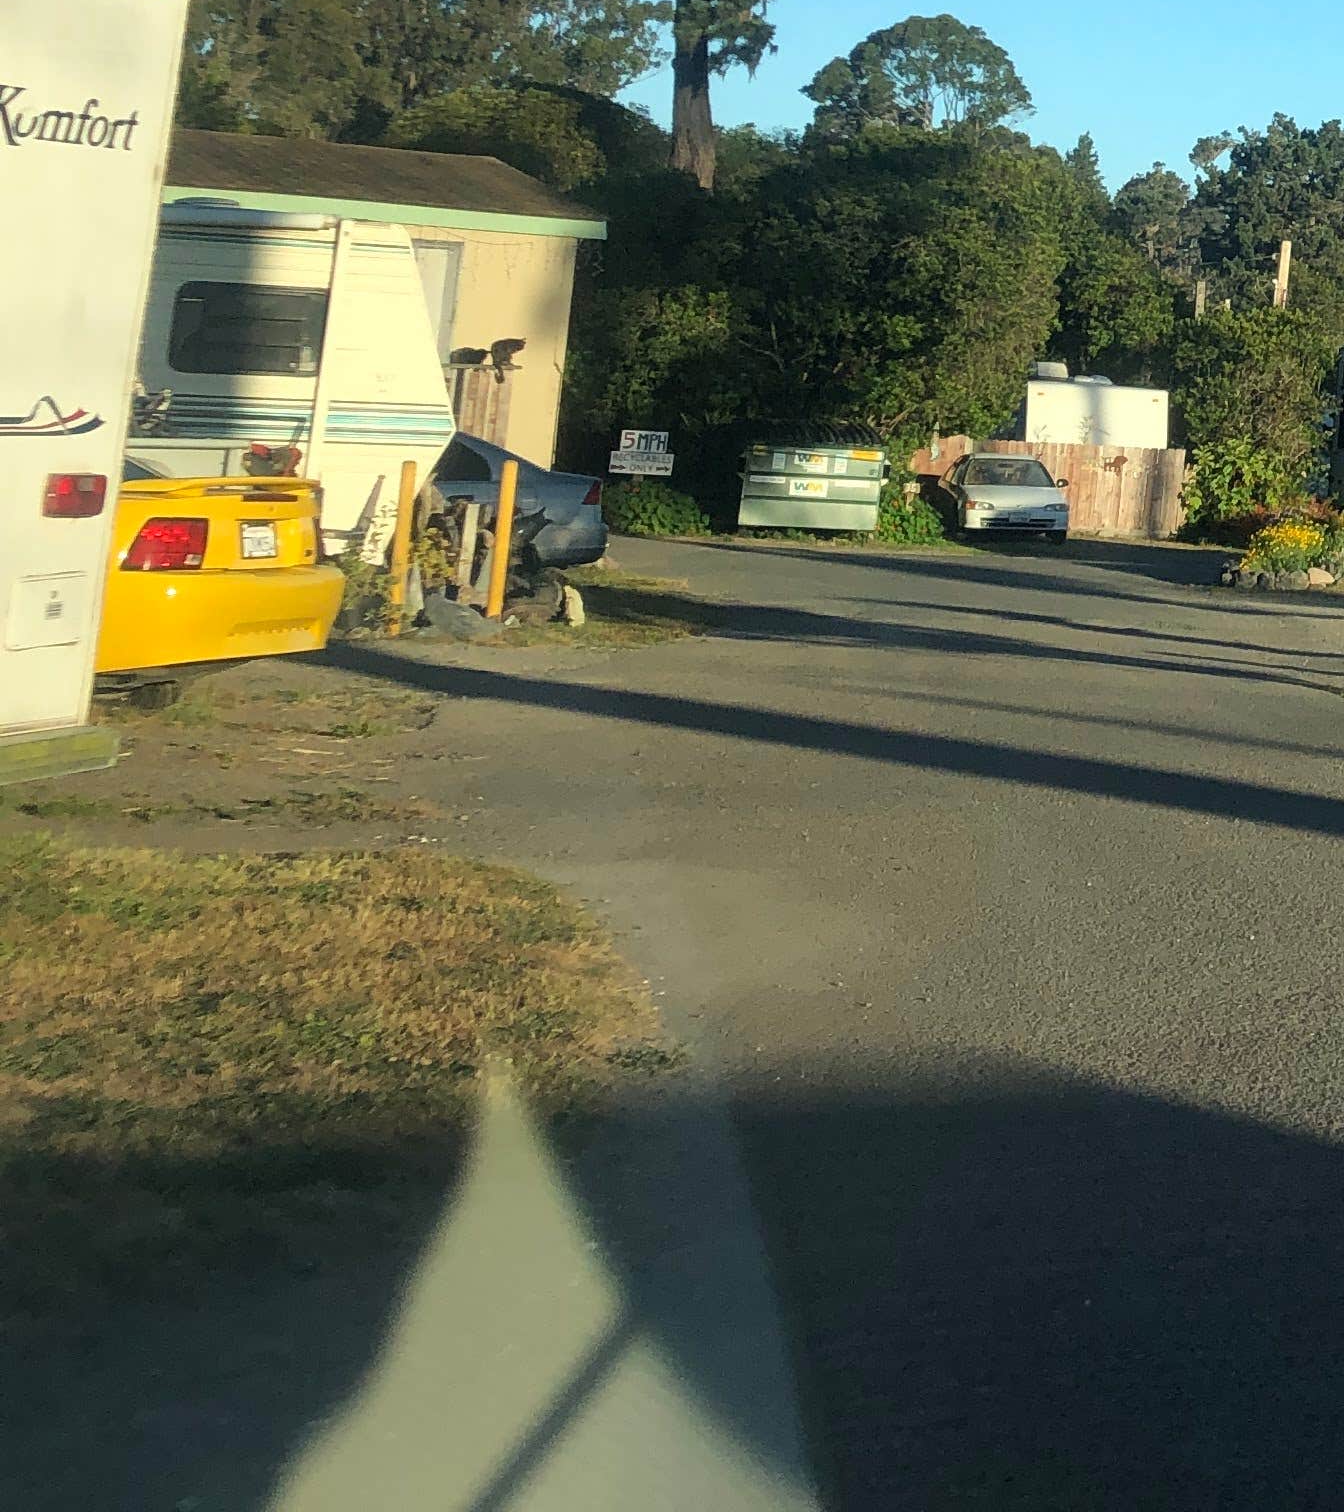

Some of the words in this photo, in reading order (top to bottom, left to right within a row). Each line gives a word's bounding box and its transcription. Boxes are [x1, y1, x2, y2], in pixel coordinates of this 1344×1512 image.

[622, 432, 636, 449] 5
[636, 433, 667, 452] MPH
[629, 464, 655, 473] ONLY
[794, 481, 824, 492] WM
